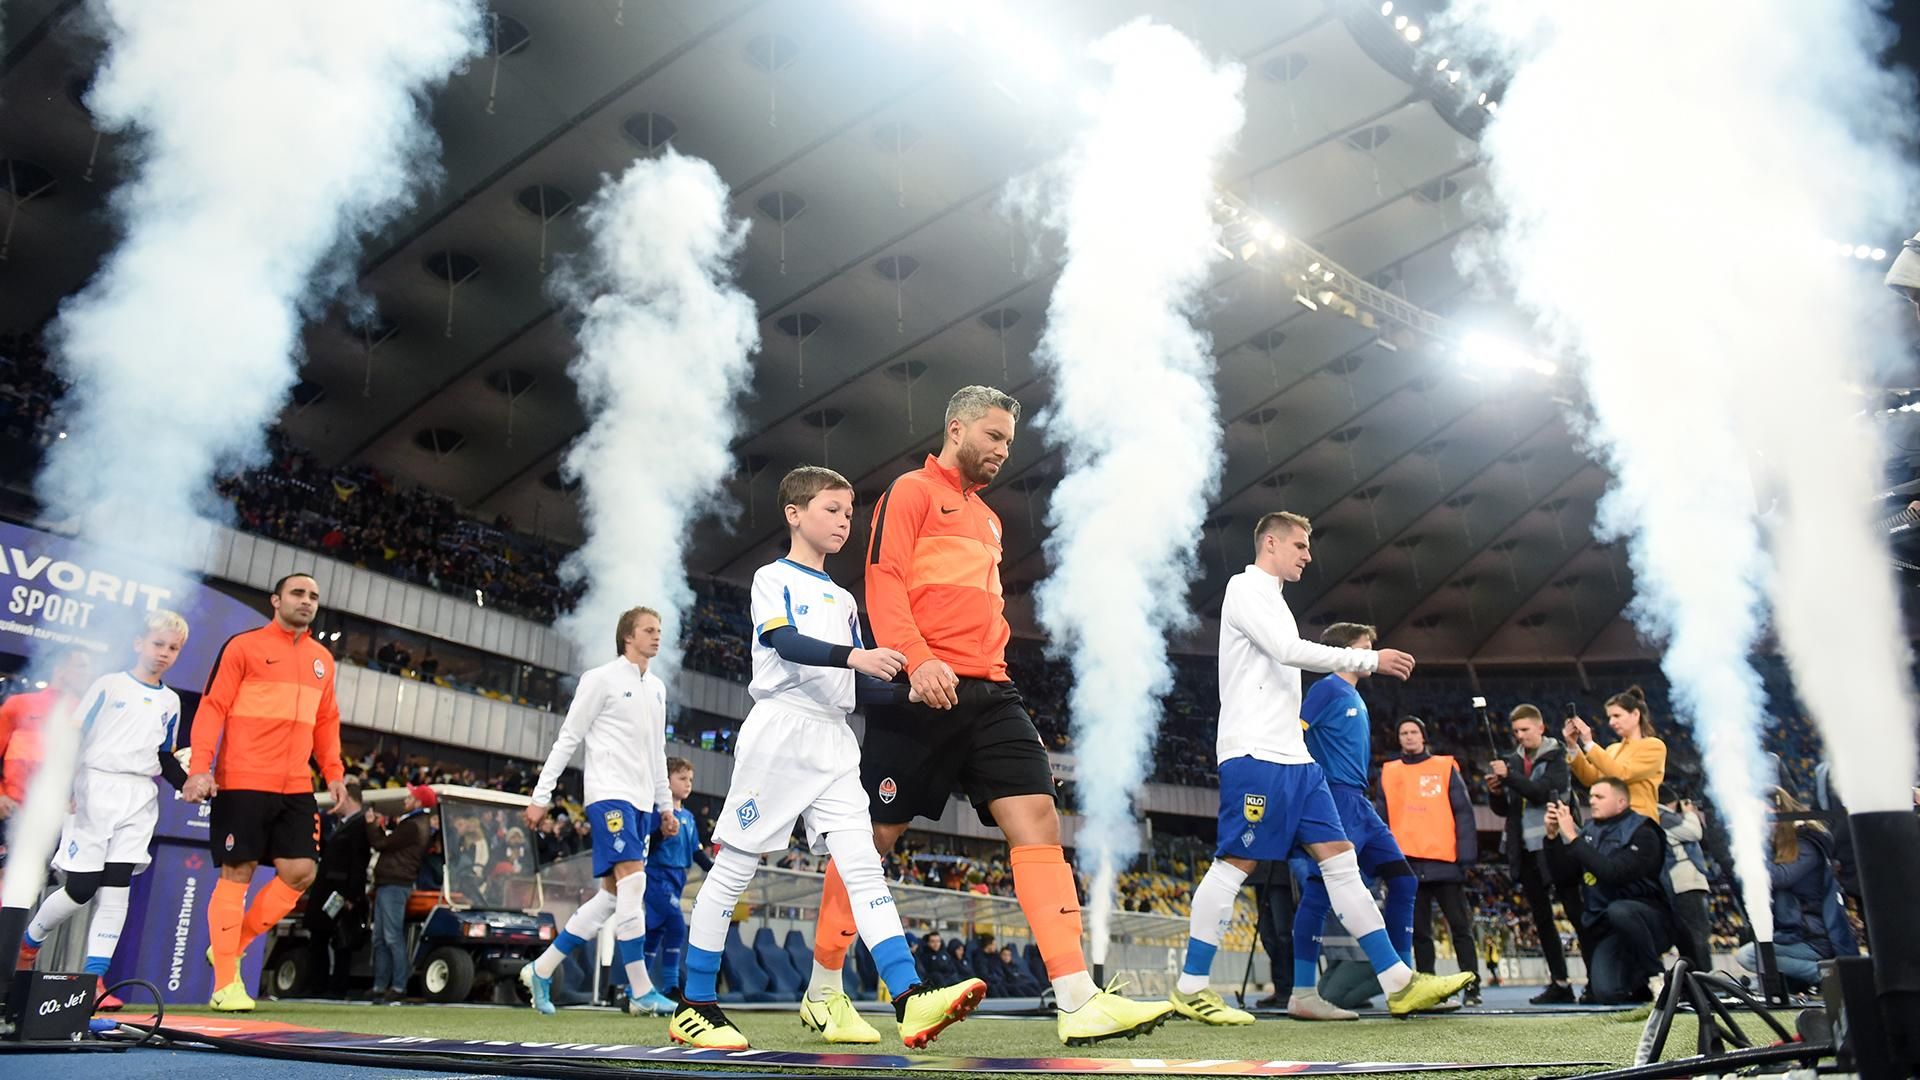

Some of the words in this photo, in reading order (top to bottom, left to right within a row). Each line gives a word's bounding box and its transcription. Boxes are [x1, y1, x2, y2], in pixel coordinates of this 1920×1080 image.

[8, 585, 95, 628] SPORT
[1247, 796, 1264, 806] KLO
[64, 990, 87, 1008] Jet
